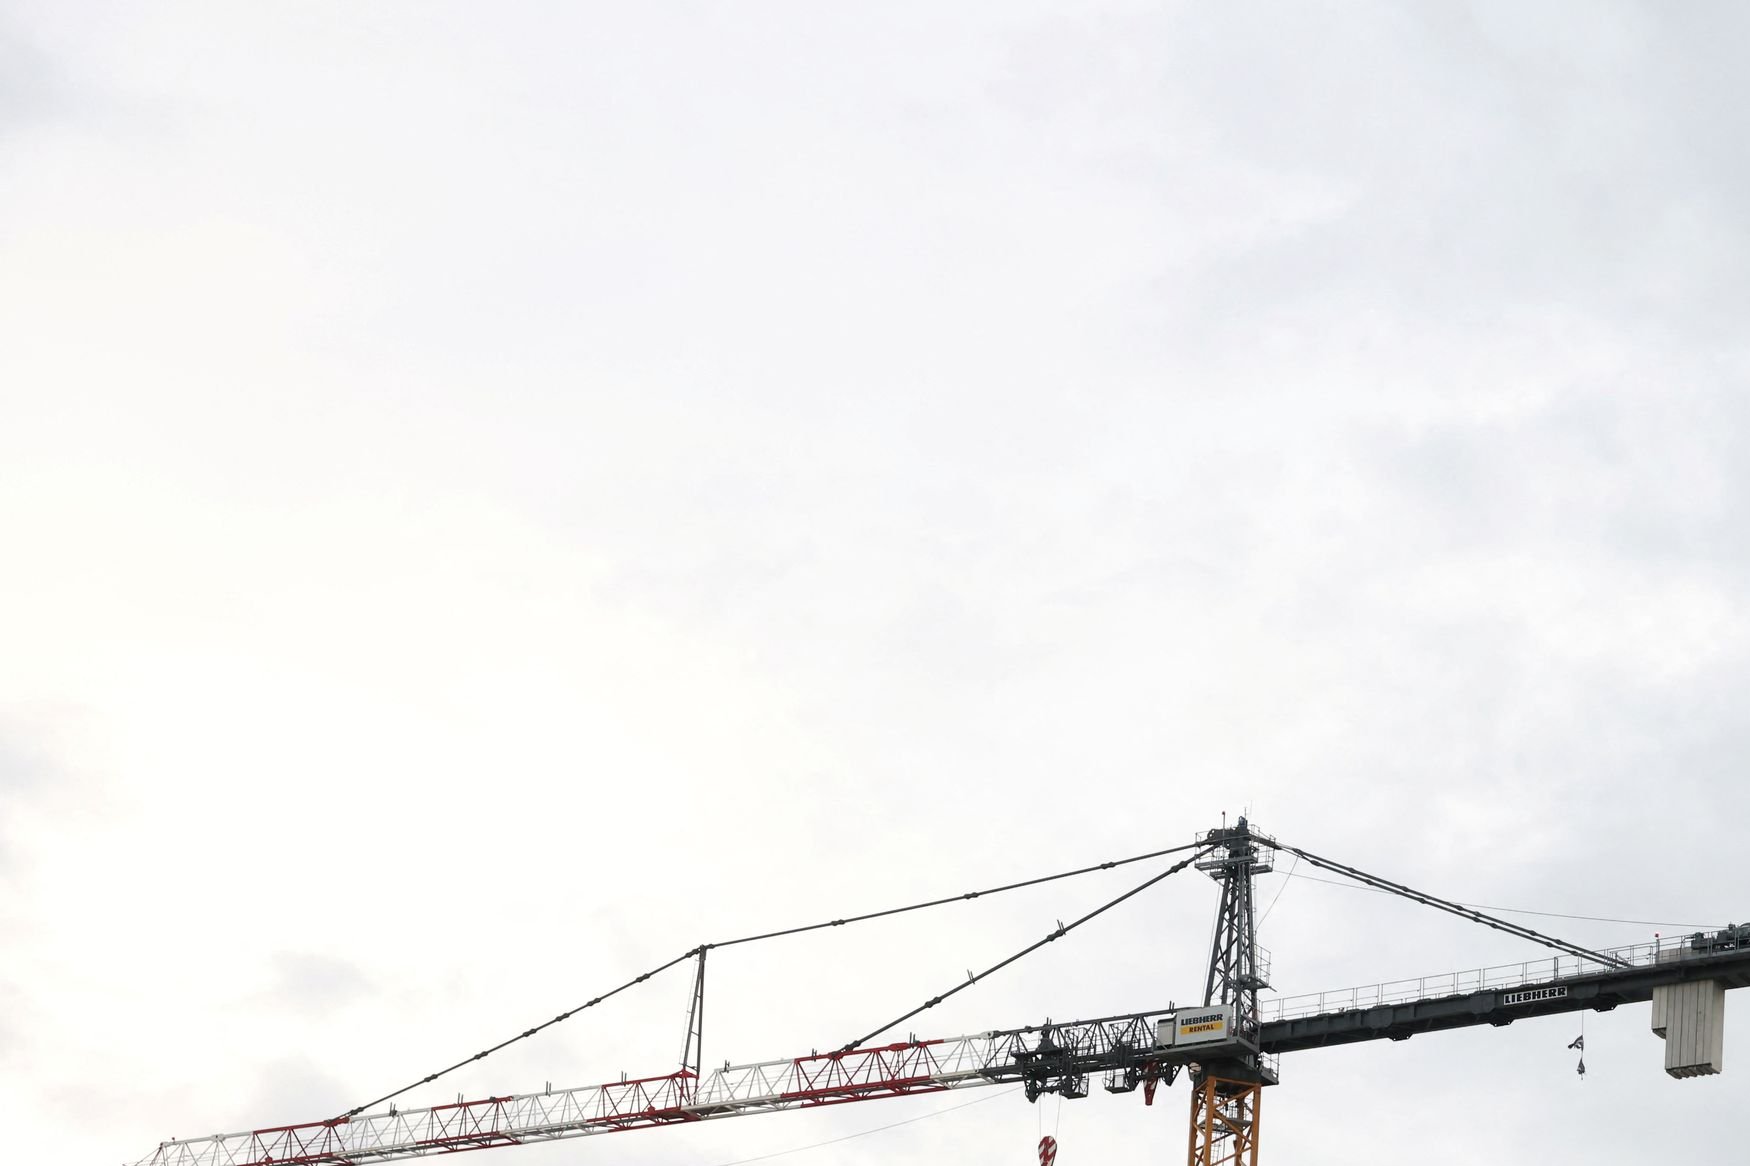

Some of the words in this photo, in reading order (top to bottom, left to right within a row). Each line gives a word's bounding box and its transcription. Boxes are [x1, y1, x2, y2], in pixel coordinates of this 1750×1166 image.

[1504, 986, 1566, 1004] LIEBHERR
[1181, 1013, 1223, 1026] LIEBHERR
[1189, 1024, 1214, 1033] RENTAL
